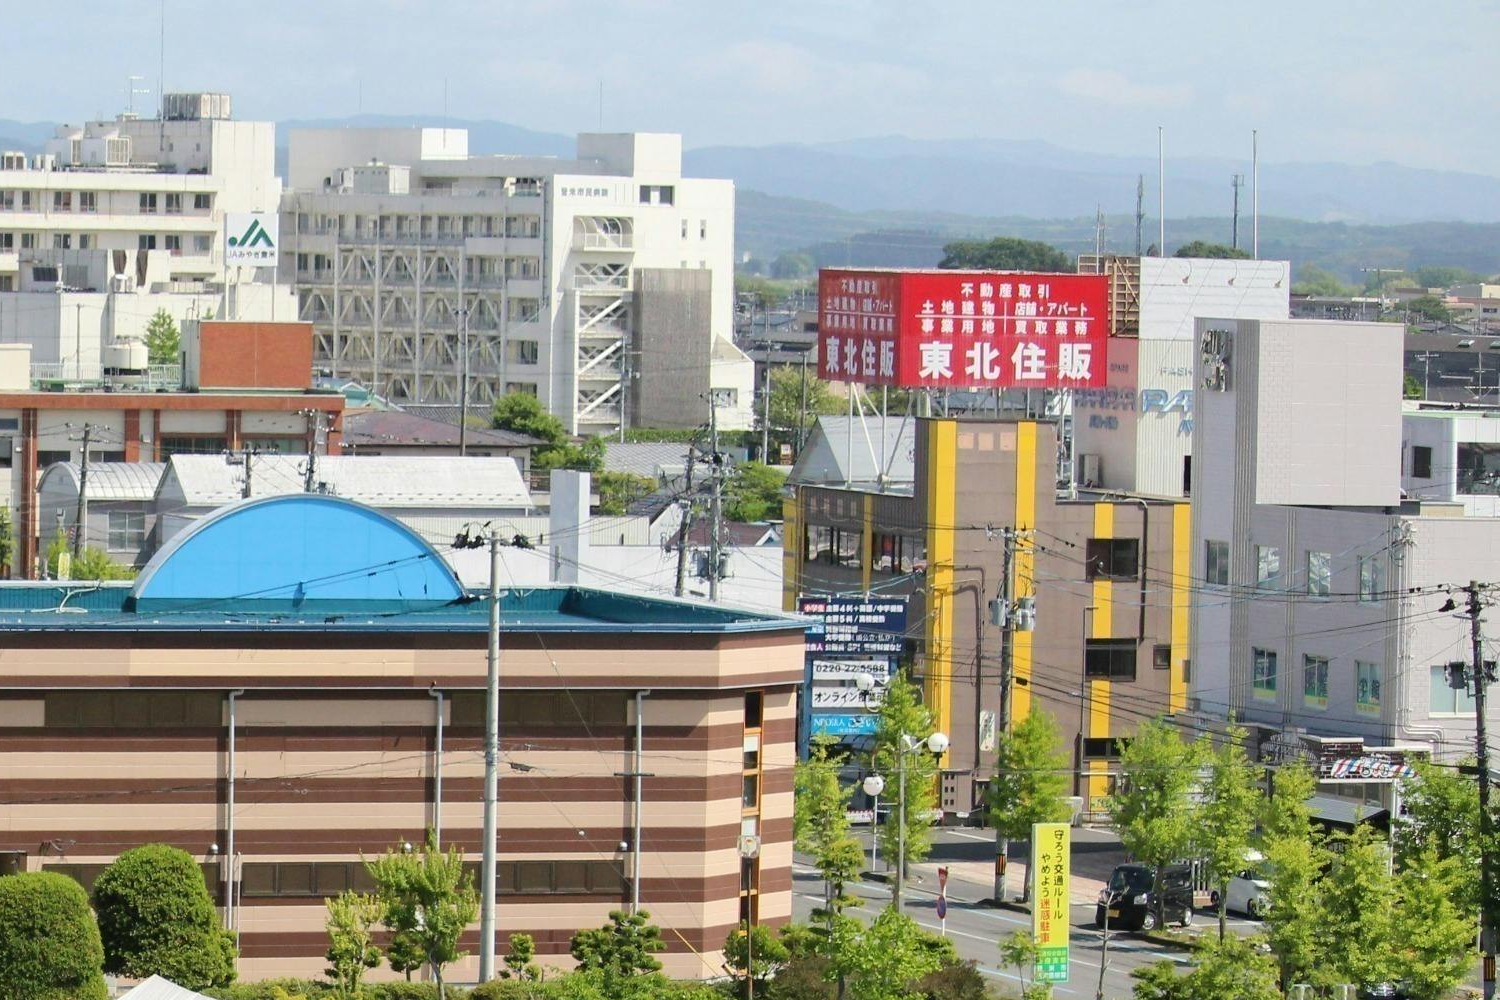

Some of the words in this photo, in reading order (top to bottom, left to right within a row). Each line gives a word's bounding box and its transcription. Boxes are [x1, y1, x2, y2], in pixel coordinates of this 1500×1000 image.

[961, 283, 1050, 298] 不動産取引
[921, 300, 995, 315] 土地建物
[921, 319, 995, 334] 事業用地
[1015, 321, 1088, 335] 買取業務
[826, 336, 894, 377] 東北住販
[918, 341, 1092, 380] 東北住販
[1053, 829, 1065, 920] 守ろう交通ルール
